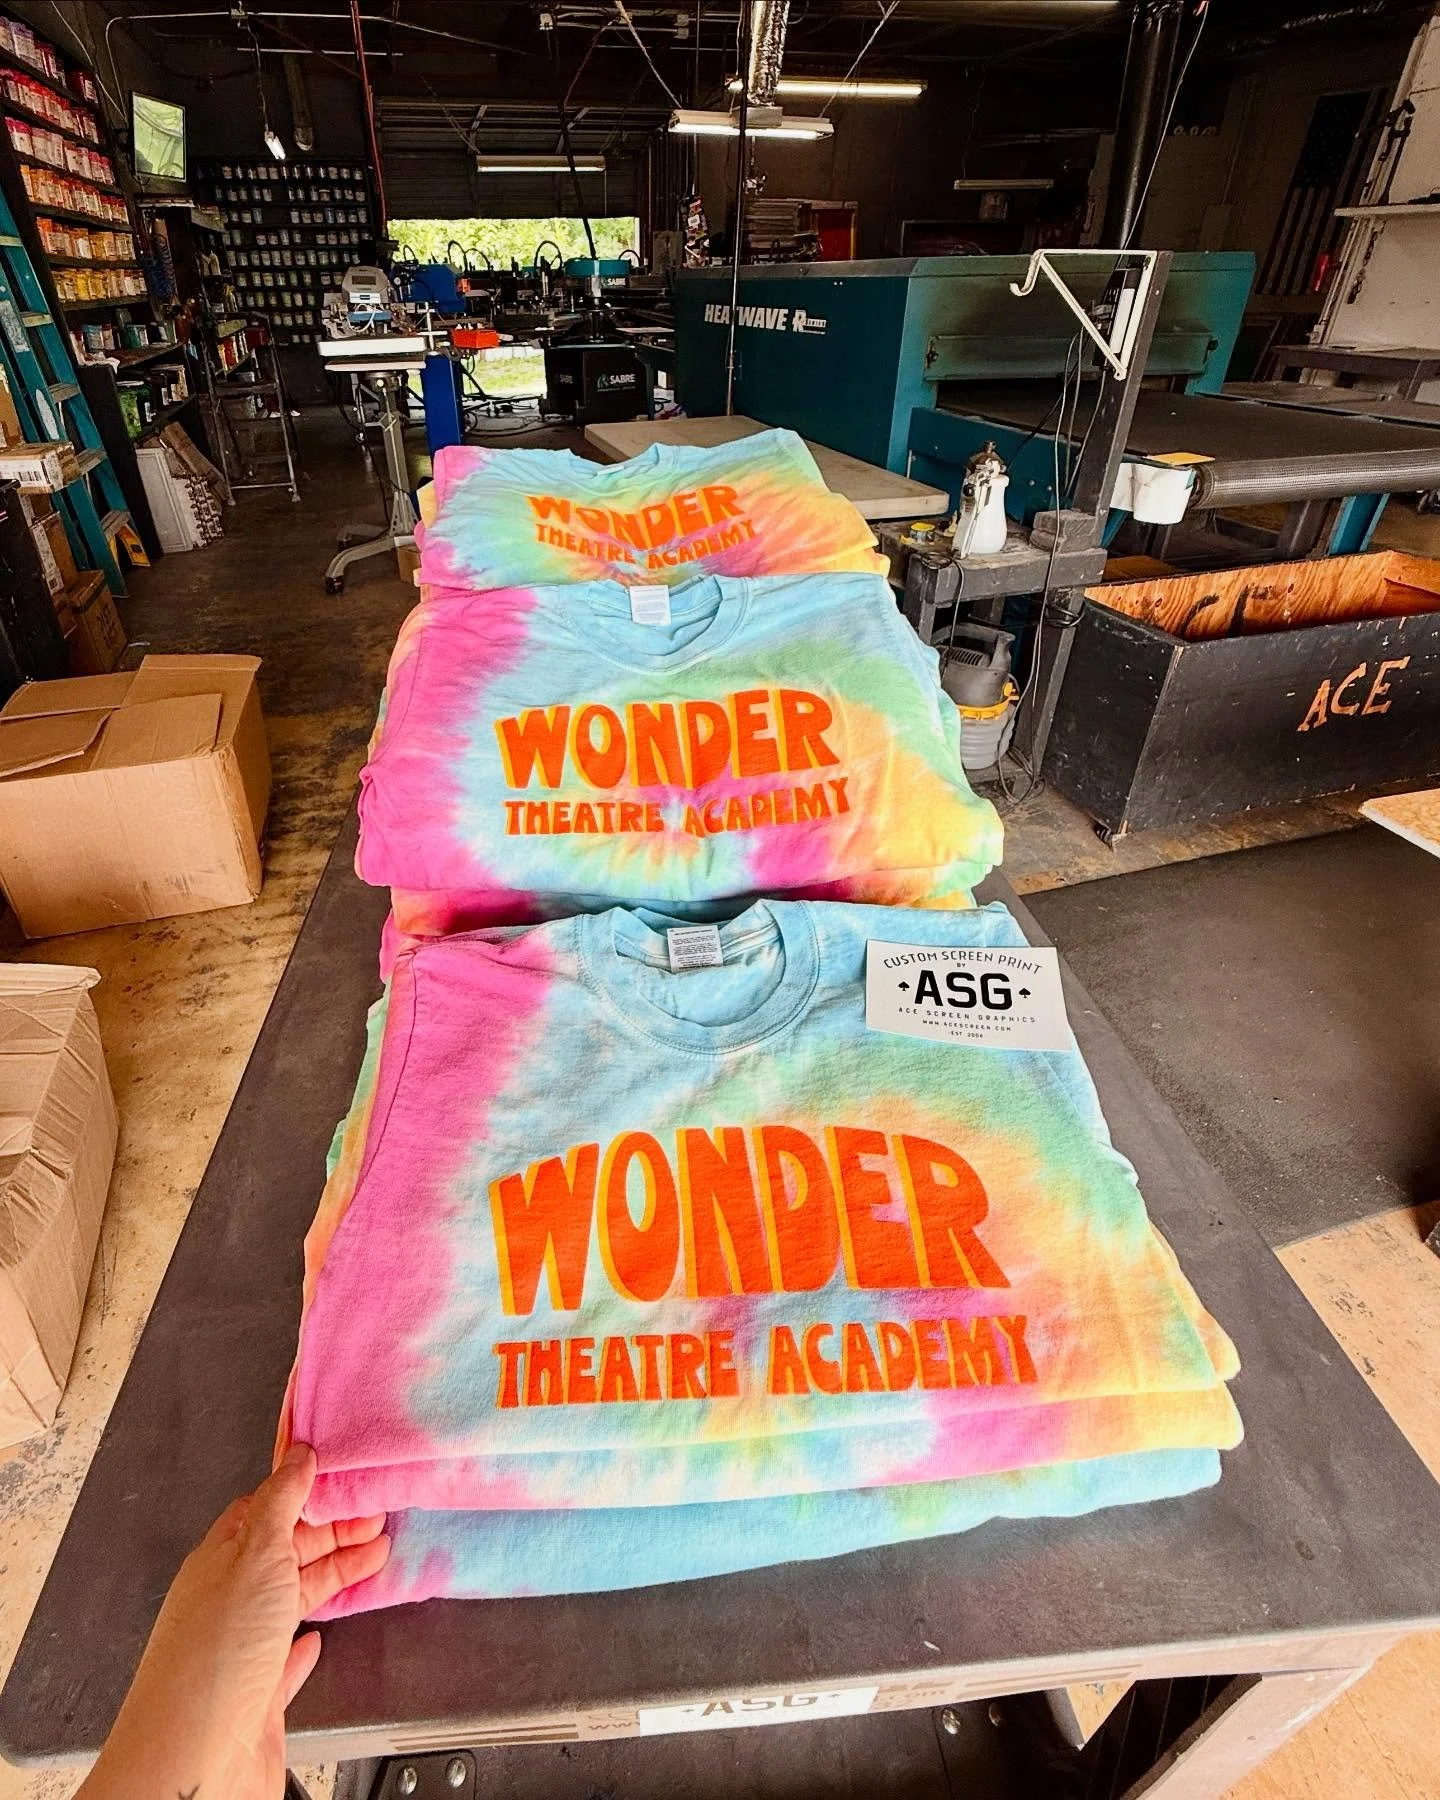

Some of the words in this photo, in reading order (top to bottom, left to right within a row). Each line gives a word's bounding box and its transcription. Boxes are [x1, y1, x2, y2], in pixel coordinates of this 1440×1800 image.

[704, 304, 788, 330] HEAWAVE
[609, 374, 636, 384] SABRE
[526, 486, 745, 550] WONDER
[535, 523, 636, 564] THEATRE
[1297, 656, 1411, 731] ACE
[494, 689, 840, 790] WONDER
[504, 801, 664, 835] THEATRE
[682, 777, 850, 837] ACADEMY
[883, 952, 938, 968] CUSTOM
[941, 951, 993, 962] SCREEN
[998, 955, 1042, 975] PRINT
[914, 969, 1013, 1010] ASG
[926, 1010, 970, 1019] SCREEN
[978, 1014, 1035, 1022] GRAPHICS
[488, 1125, 1011, 1316] WONDER
[493, 1338, 742, 1408] THEATRE
[767, 1315, 1038, 1395] ACADEMY
